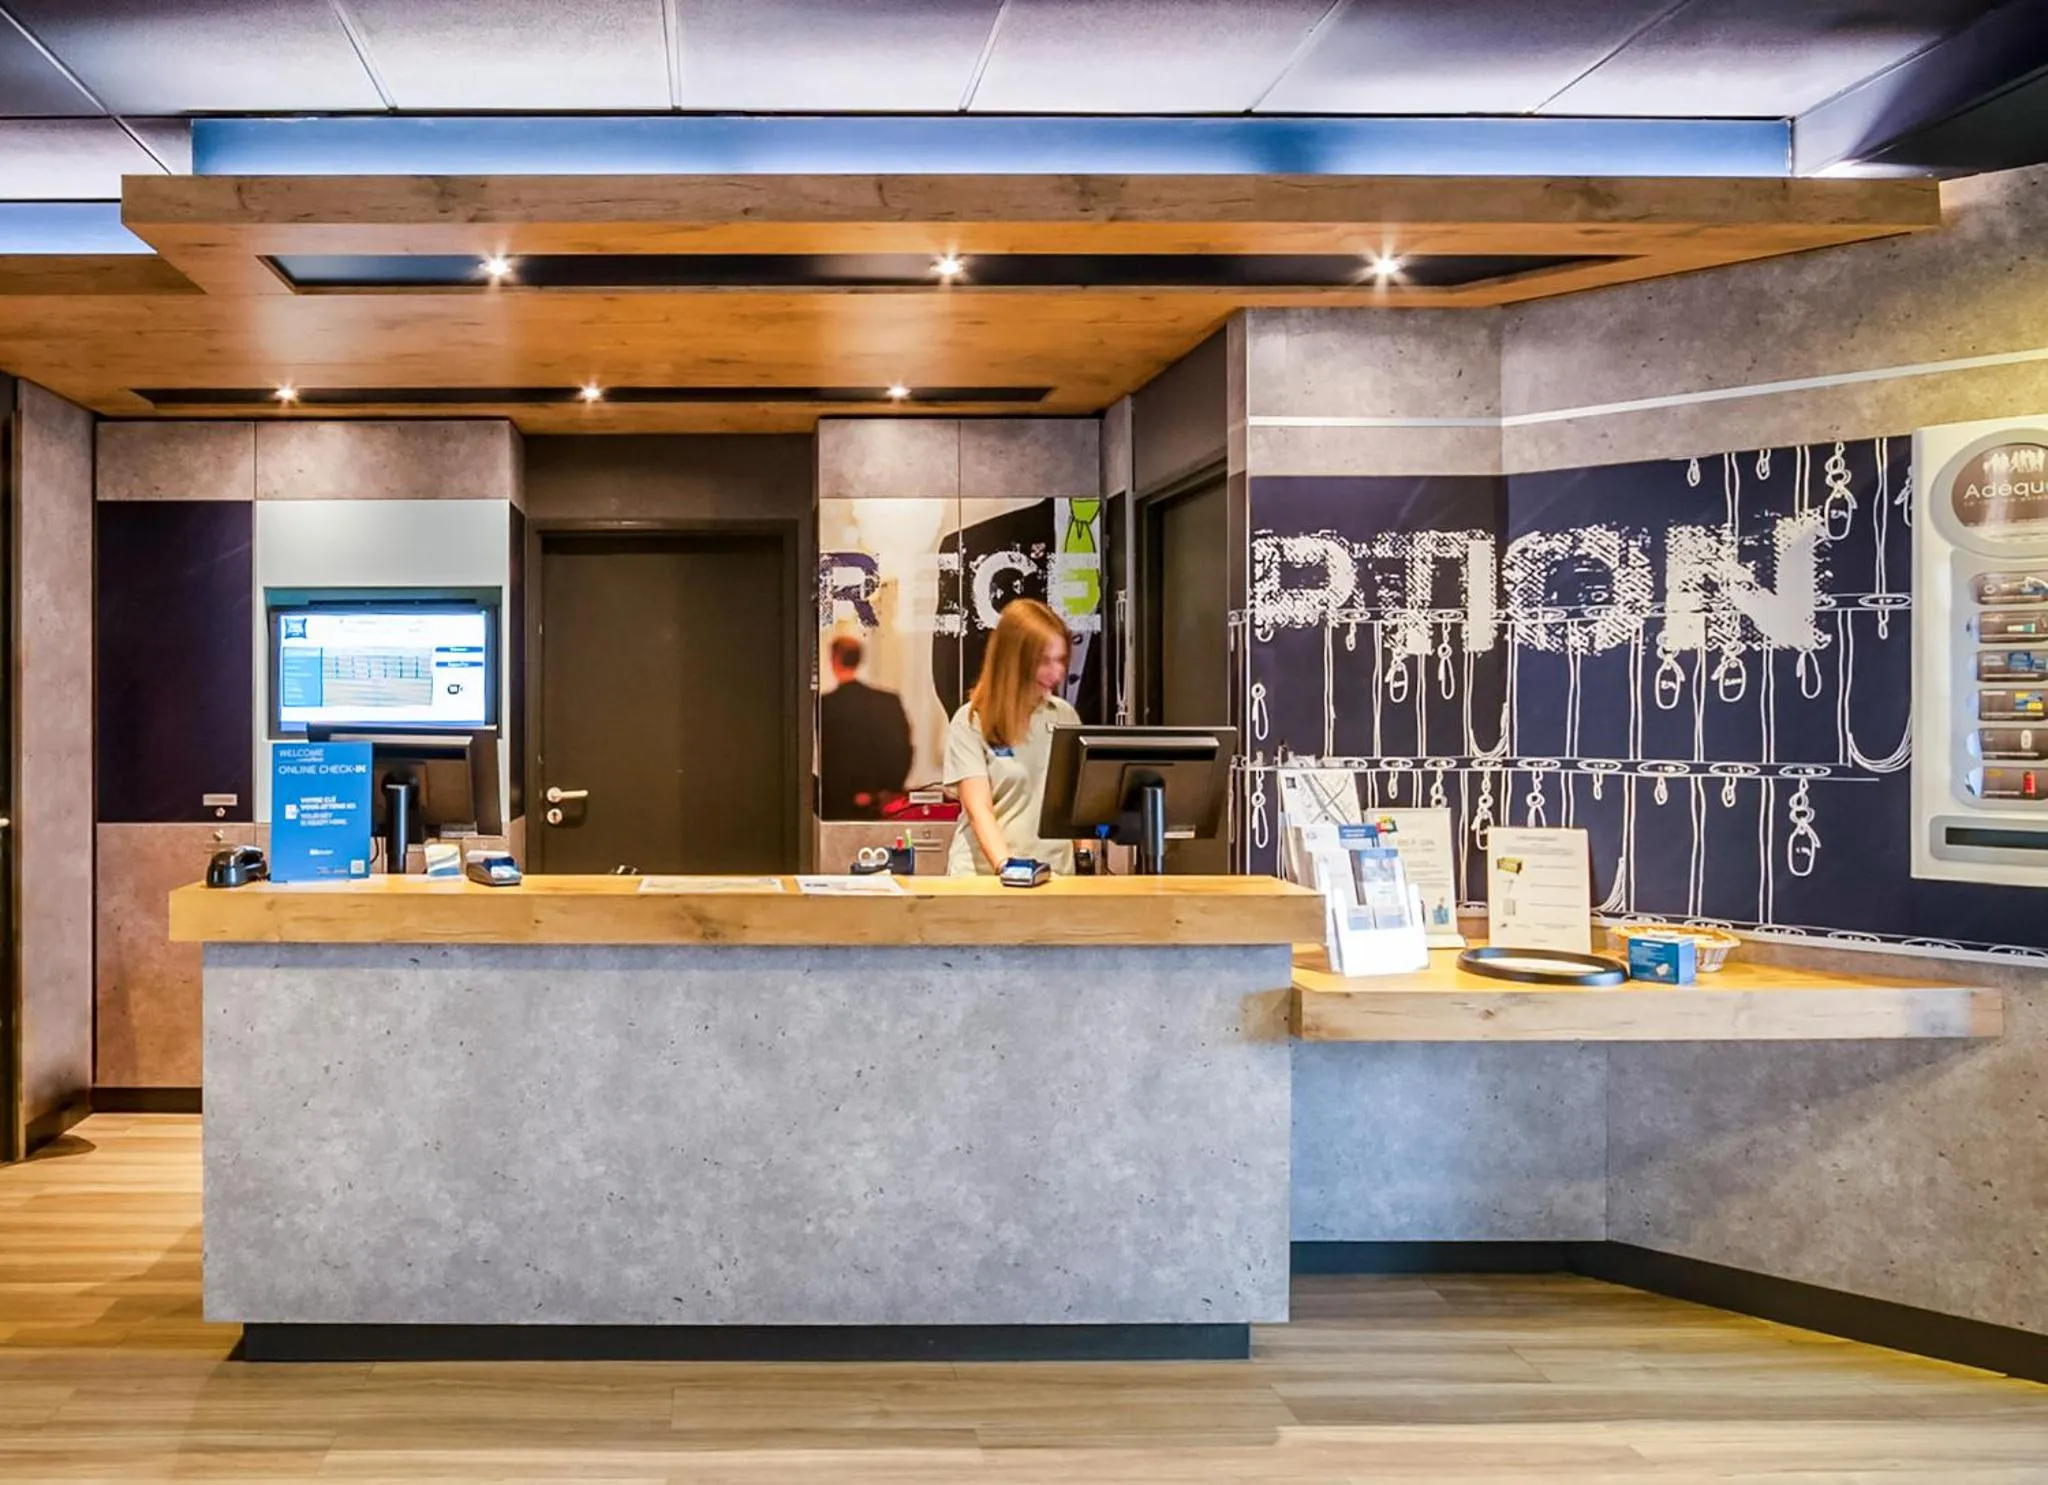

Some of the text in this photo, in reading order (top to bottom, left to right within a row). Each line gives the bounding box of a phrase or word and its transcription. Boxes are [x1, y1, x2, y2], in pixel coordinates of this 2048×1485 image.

[819, 551, 1101, 634] RECE
[279, 748, 324, 758] WELCOME
[278, 764, 367, 775] ONLINE CHECK-IN
